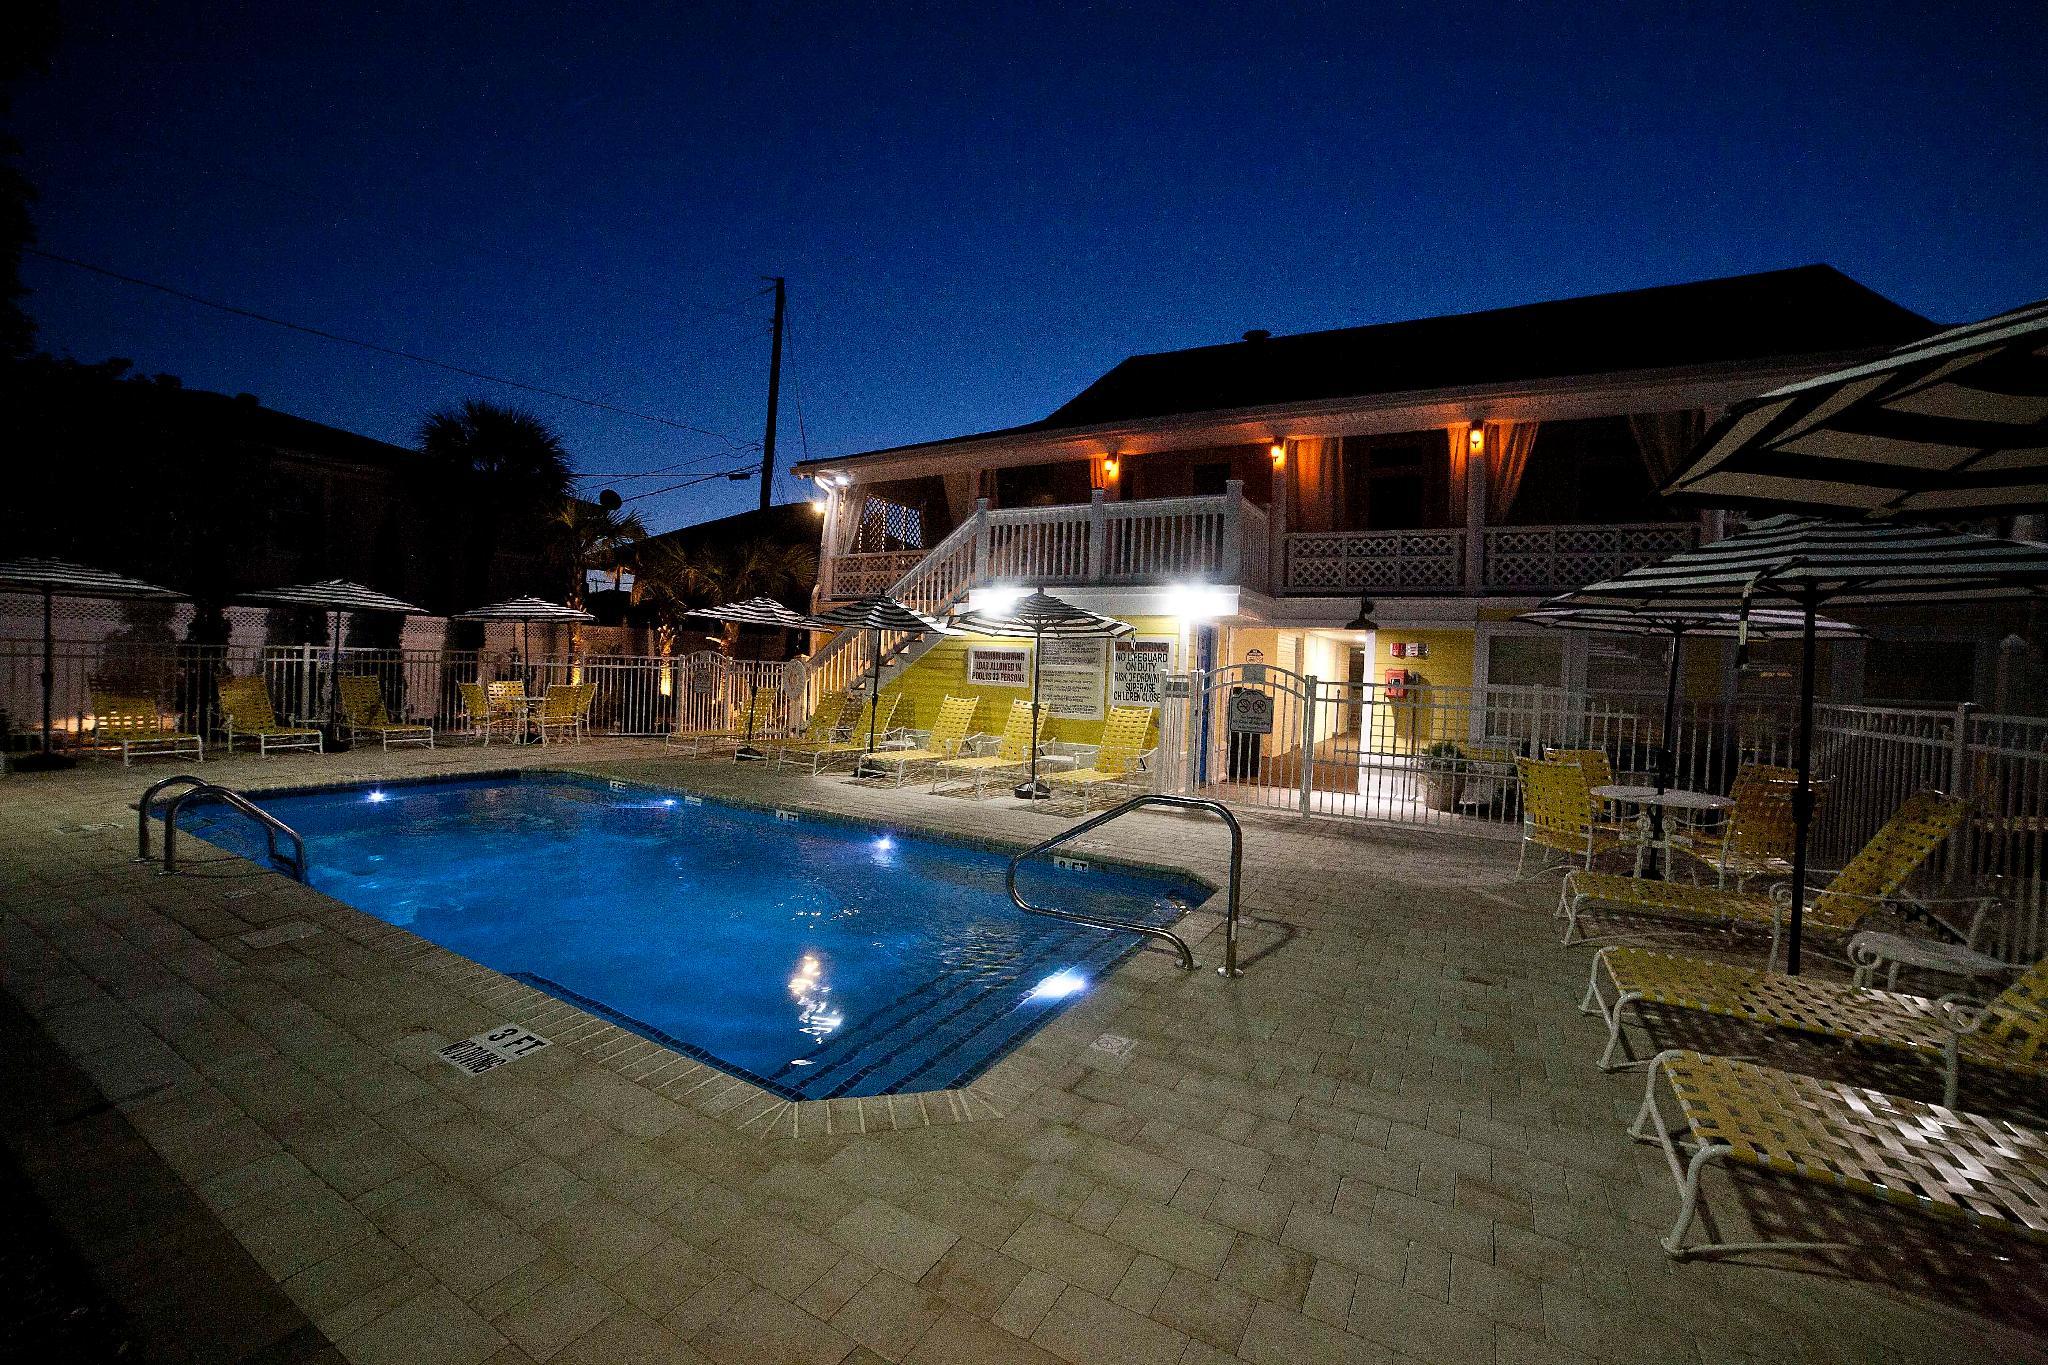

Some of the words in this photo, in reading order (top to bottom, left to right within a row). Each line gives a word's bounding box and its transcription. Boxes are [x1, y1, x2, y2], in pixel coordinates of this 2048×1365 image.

[1116, 653, 1127, 661] NO
[976, 662, 989, 670] LOAD
[990, 662, 1015, 671] ALLOWED
[1016, 663, 1022, 672] IN
[1126, 662, 1136, 671] ON
[1138, 662, 1157, 671] DUTY
[972, 672, 985, 680] POOL
[985, 672, 992, 680] IS
[1001, 673, 1025, 682] PERSONS
[1115, 672, 1127, 682] RISK
[1129, 673, 1136, 682] OF
[1126, 683, 1155, 692] SUPERVISE
[1114, 691, 1140, 701] CHILDREN
[488, 1028, 519, 1042] 3
